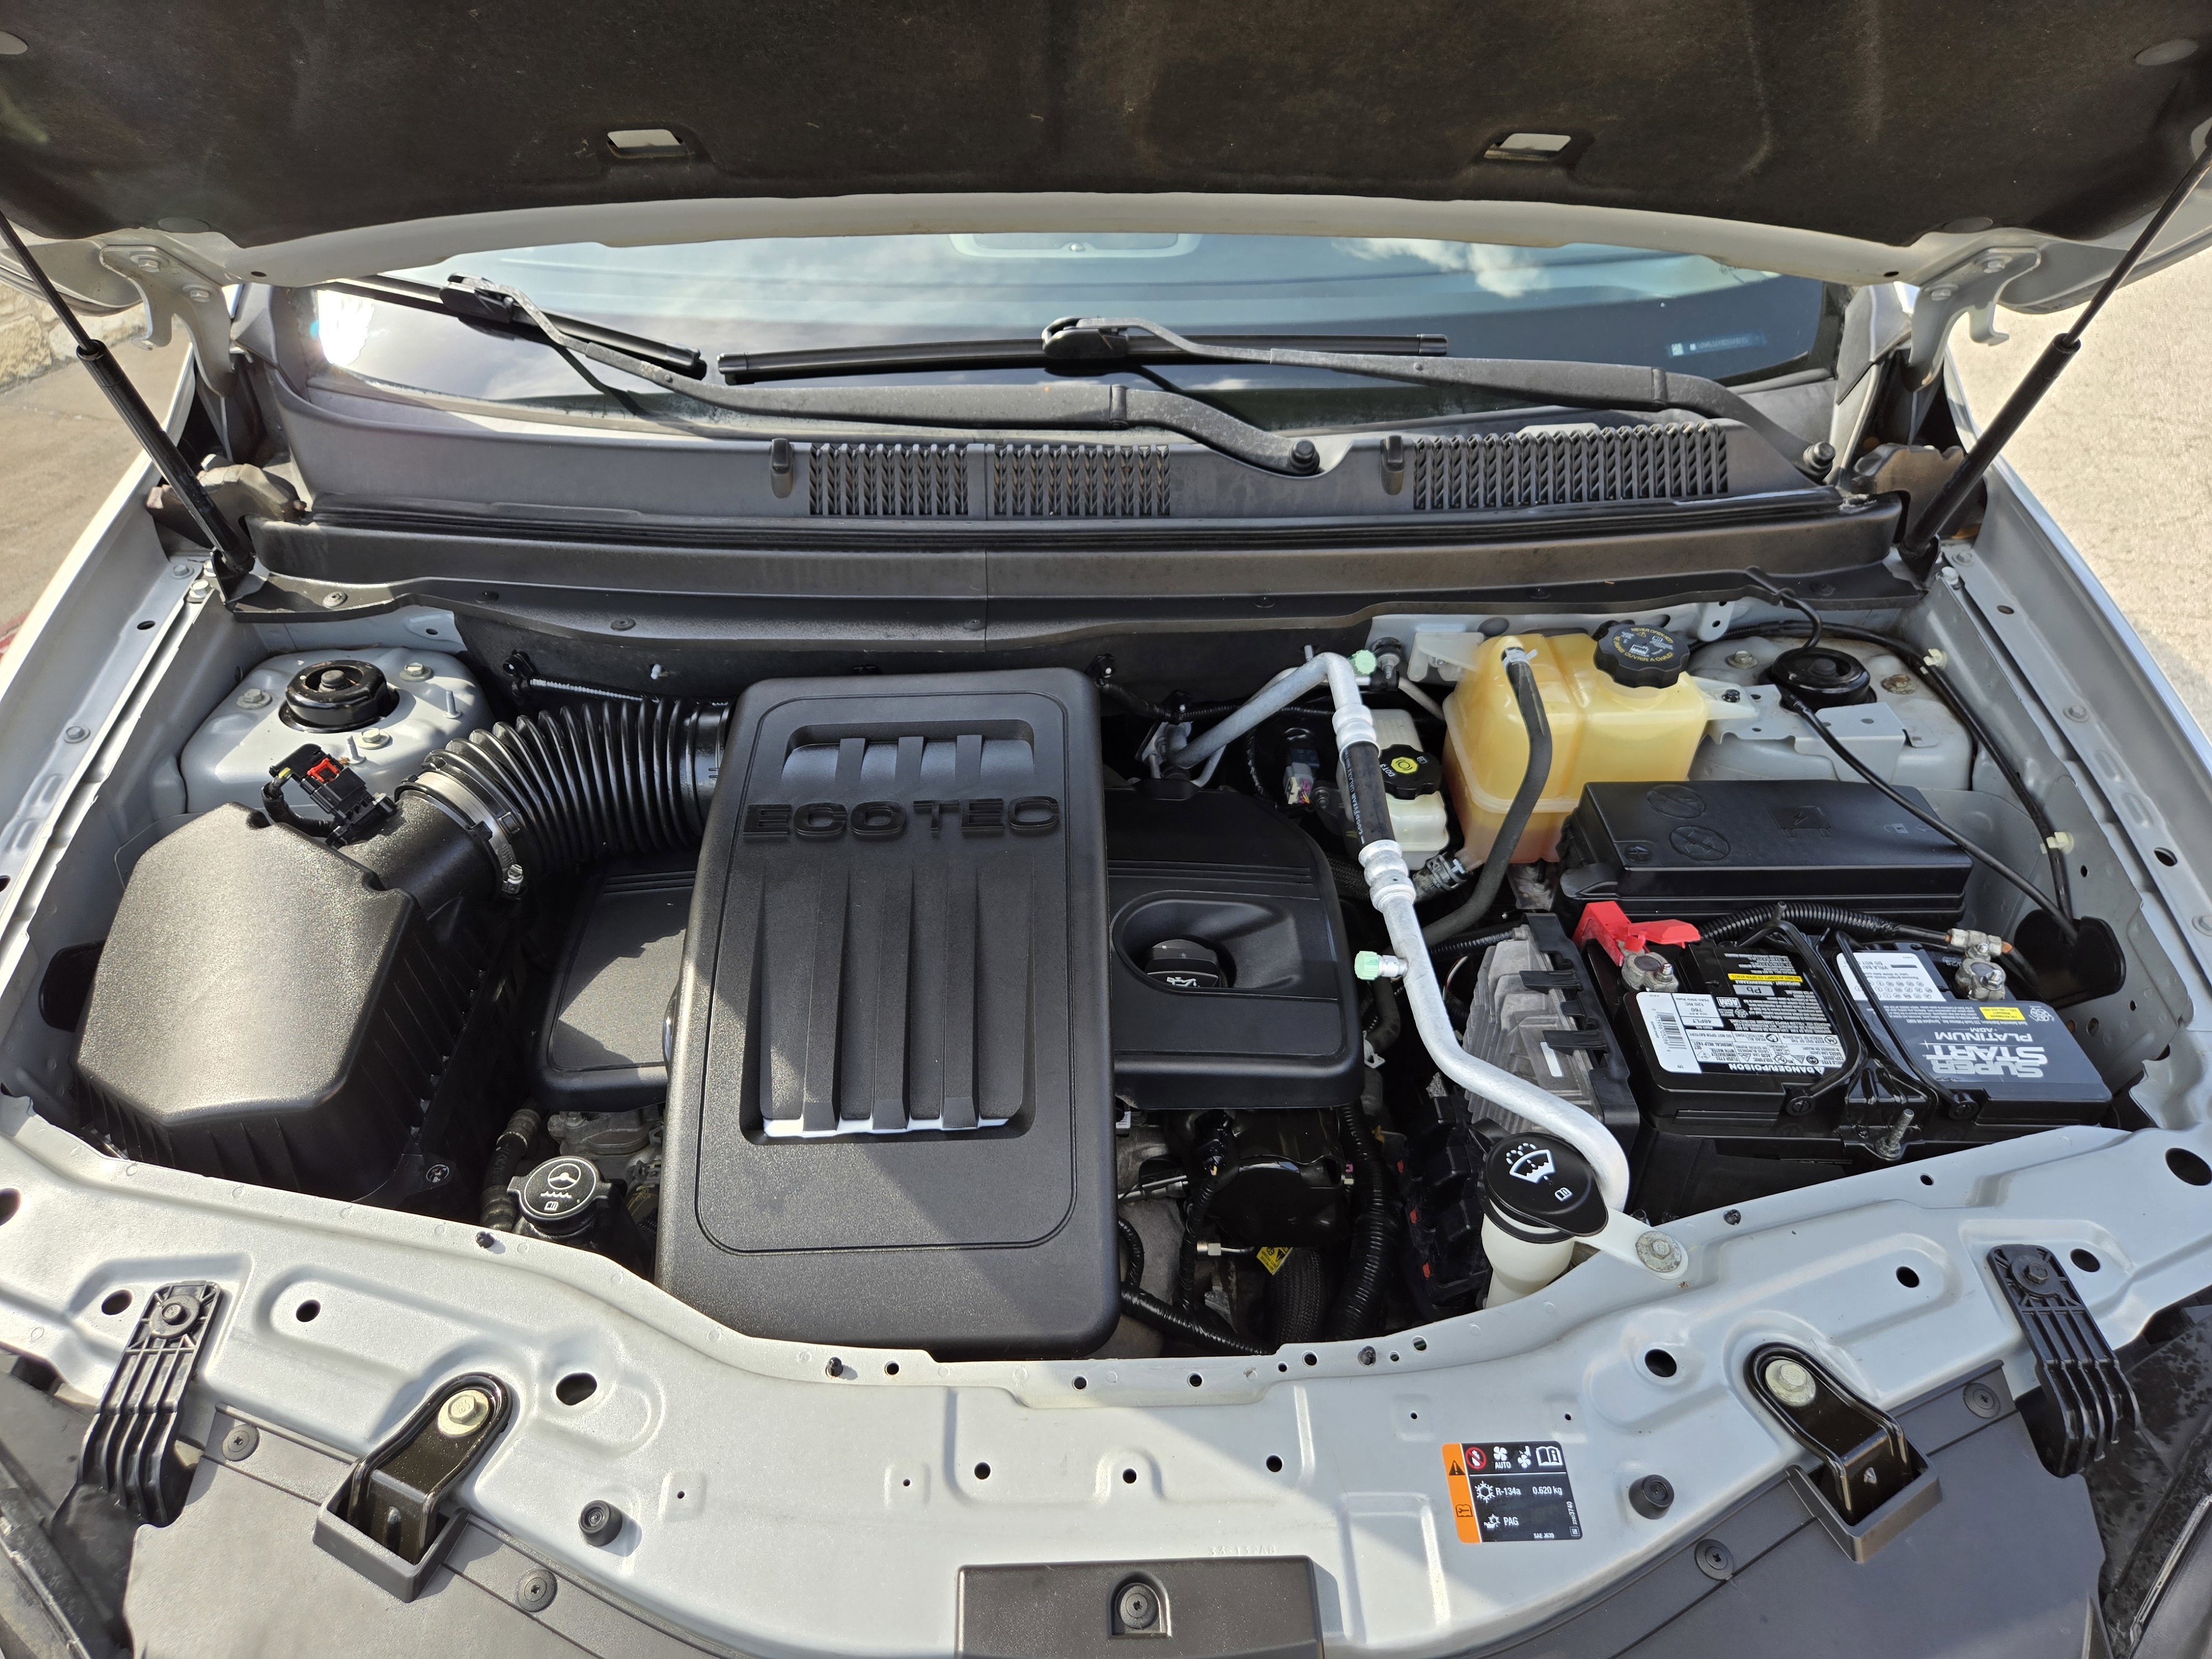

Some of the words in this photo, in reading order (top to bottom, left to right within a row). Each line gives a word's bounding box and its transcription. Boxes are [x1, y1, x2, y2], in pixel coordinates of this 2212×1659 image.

[1625, 653, 1648, 662] OUVRIR
[1655, 651, 1674, 662] CHAUD
[743, 795, 1060, 837] ECOTEC
[1350, 792, 1363, 836] GOODYEAR
[1718, 998, 1739, 1006] AGM
[1934, 1031, 2033, 1042] PLATINUM
[1926, 1045, 2048, 1065] START
[1728, 1063, 1815, 1074] DANGER/POISON
[1929, 1060, 2044, 1078] SUPER
[1495, 1461, 1511, 1469] AUTO
[1495, 1487, 1522, 1495] R-134a
[1532, 1486, 1552, 1495] 0.620
[1552, 1486, 1563, 1495] kg
[1503, 1516, 1520, 1526] PAG
